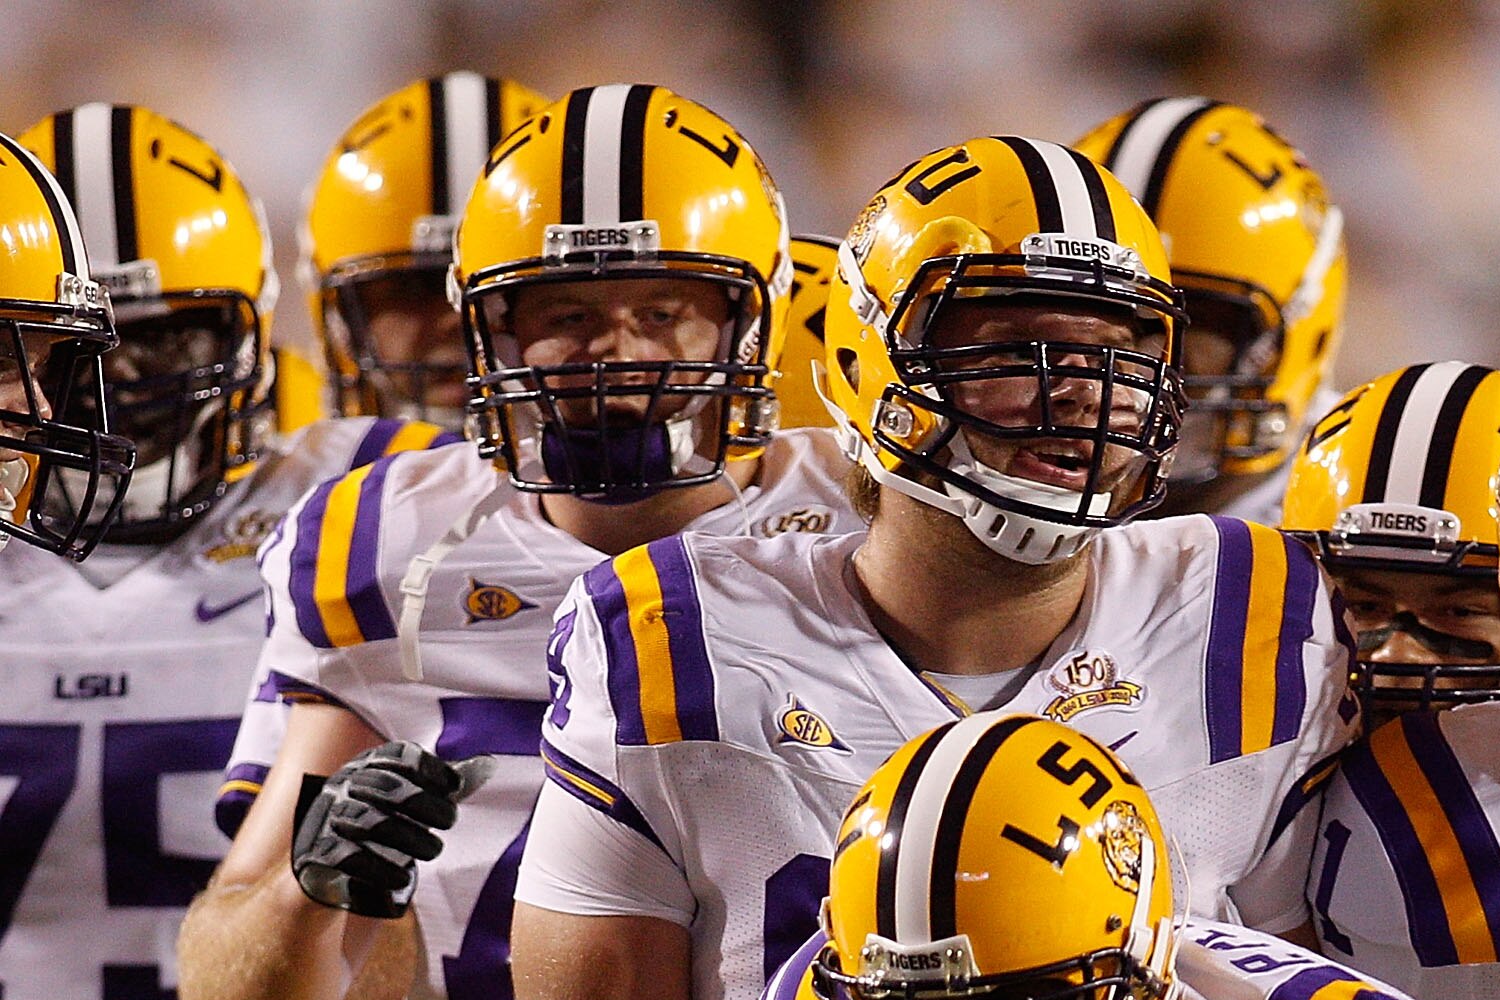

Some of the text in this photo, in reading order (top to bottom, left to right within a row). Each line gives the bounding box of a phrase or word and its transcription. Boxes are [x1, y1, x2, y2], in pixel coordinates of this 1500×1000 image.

[571, 228, 630, 247] TIGERS
[1054, 239, 1112, 261] TIGERS
[1370, 512, 1427, 532] TIGERS
[1063, 651, 1106, 688] 150
[54, 674, 128, 700] LSU
[793, 713, 823, 743] SEC
[1001, 736, 1130, 869] LS
[888, 950, 942, 971] TIGERS
